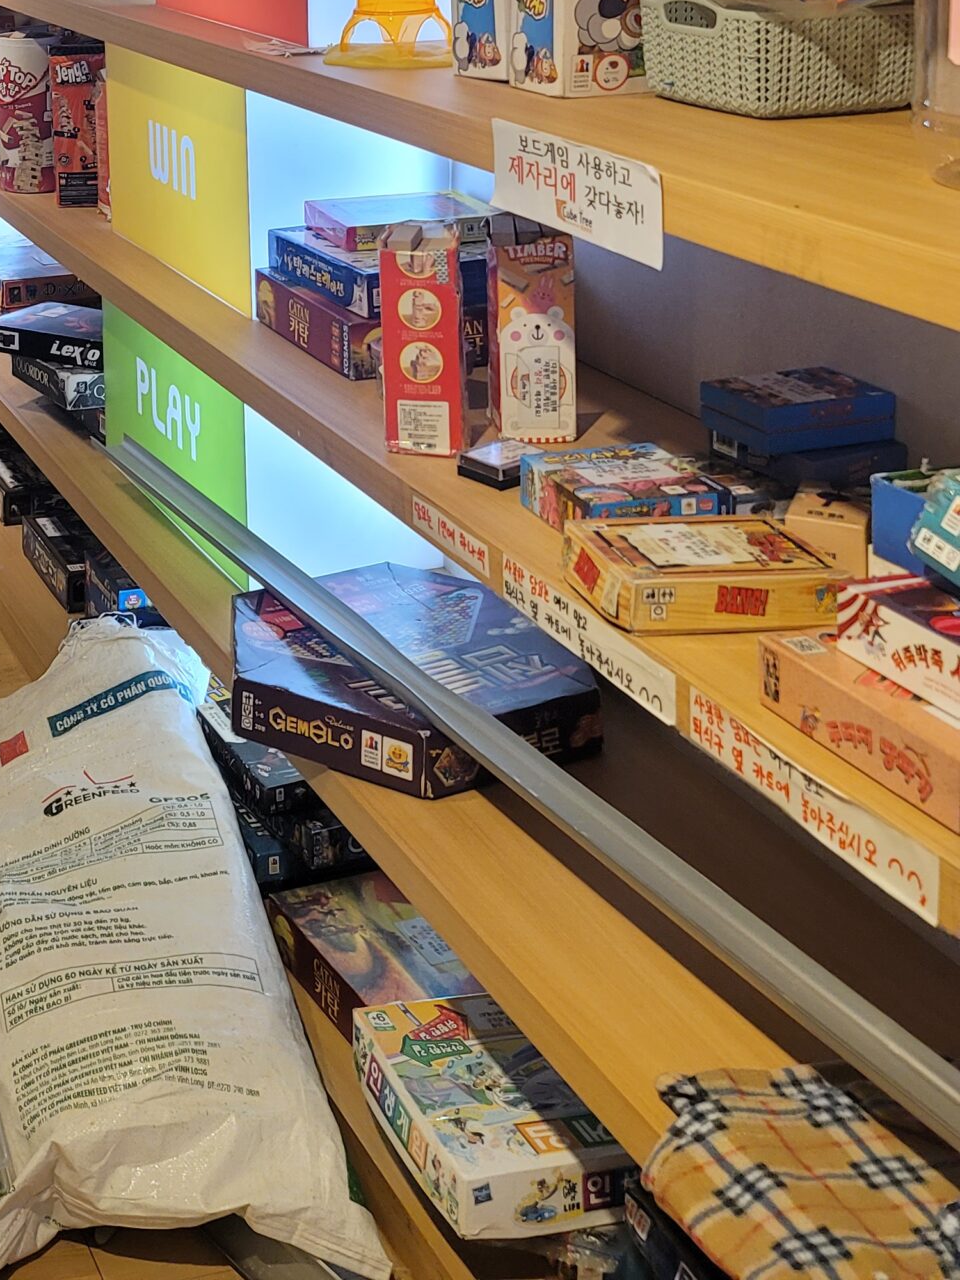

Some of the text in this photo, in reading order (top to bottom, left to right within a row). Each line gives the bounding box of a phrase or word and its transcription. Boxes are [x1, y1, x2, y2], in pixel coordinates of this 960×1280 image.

[55, 61, 89, 84] Jenga
[148, 119, 196, 201] WIN
[518, 134, 632, 188] 보드게임 사용하고
[509, 155, 646, 226] 제자리에 갖다놓자!
[504, 241, 566, 259] TIMBER
[289, 298, 310, 324] CATAN
[289, 316, 310, 349] 카탄
[50, 340, 101, 365] Lexio
[16, 356, 50, 388] QUORIDOR
[136, 356, 201, 462] PLAY
[504, 558, 525, 587] 사용한
[529, 574, 550, 603] 담요는
[714, 585, 769, 616] BANG!
[891, 642, 944, 673] 뒤죽박죽
[268, 706, 354, 750] GEMBLO
[694, 695, 725, 734] 사용한
[752, 760, 790, 803] 카트에
[43, 787, 140, 817] GREENFEED
[65, 972, 76, 980] 60
[313, 958, 340, 999] CATAN
[314, 977, 340, 1023] 카탄
